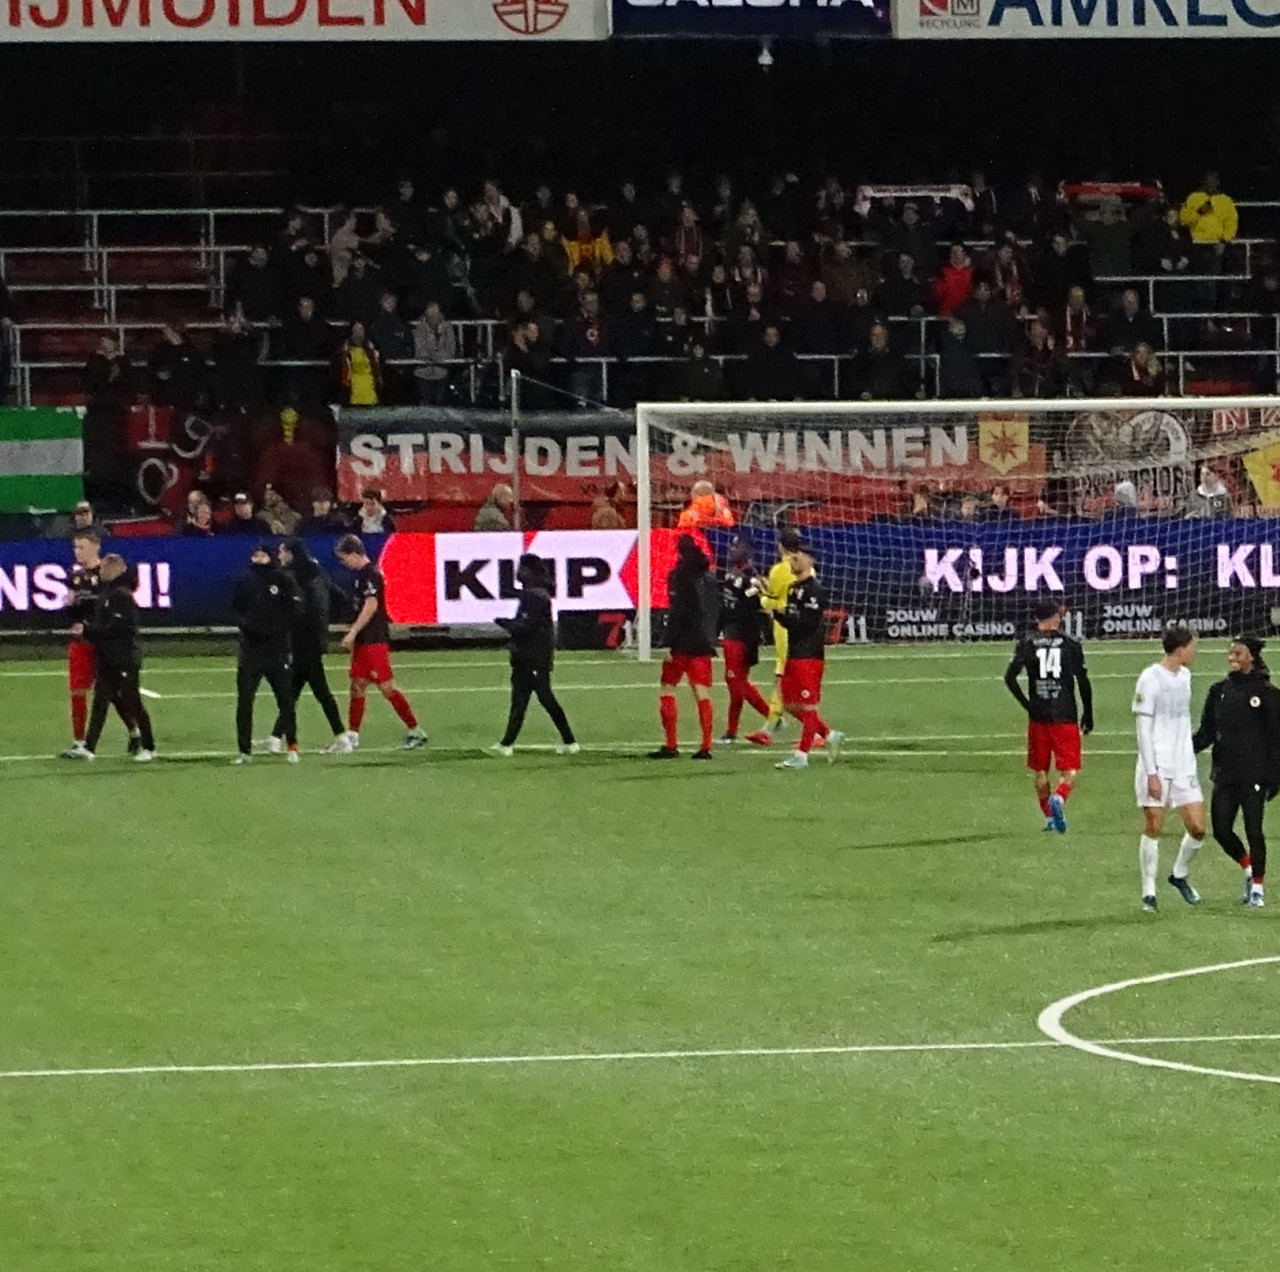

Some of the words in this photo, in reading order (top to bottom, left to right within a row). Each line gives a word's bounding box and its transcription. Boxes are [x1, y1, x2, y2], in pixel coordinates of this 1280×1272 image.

[349, 432, 639, 478] STRIJDEN
[668, 435, 707, 477] &
[727, 425, 969, 474] WINNEN
[924, 546, 1064, 592] KIJK
[1083, 545, 1178, 590] OP:
[886, 609, 938, 623] JOUW
[1102, 604, 1153, 618] JOUW
[887, 623, 950, 638] ONLINE
[951, 622, 1015, 637] CASINO
[1103, 619, 1162, 633] ONLINE
[1036, 648, 1062, 679] 14
